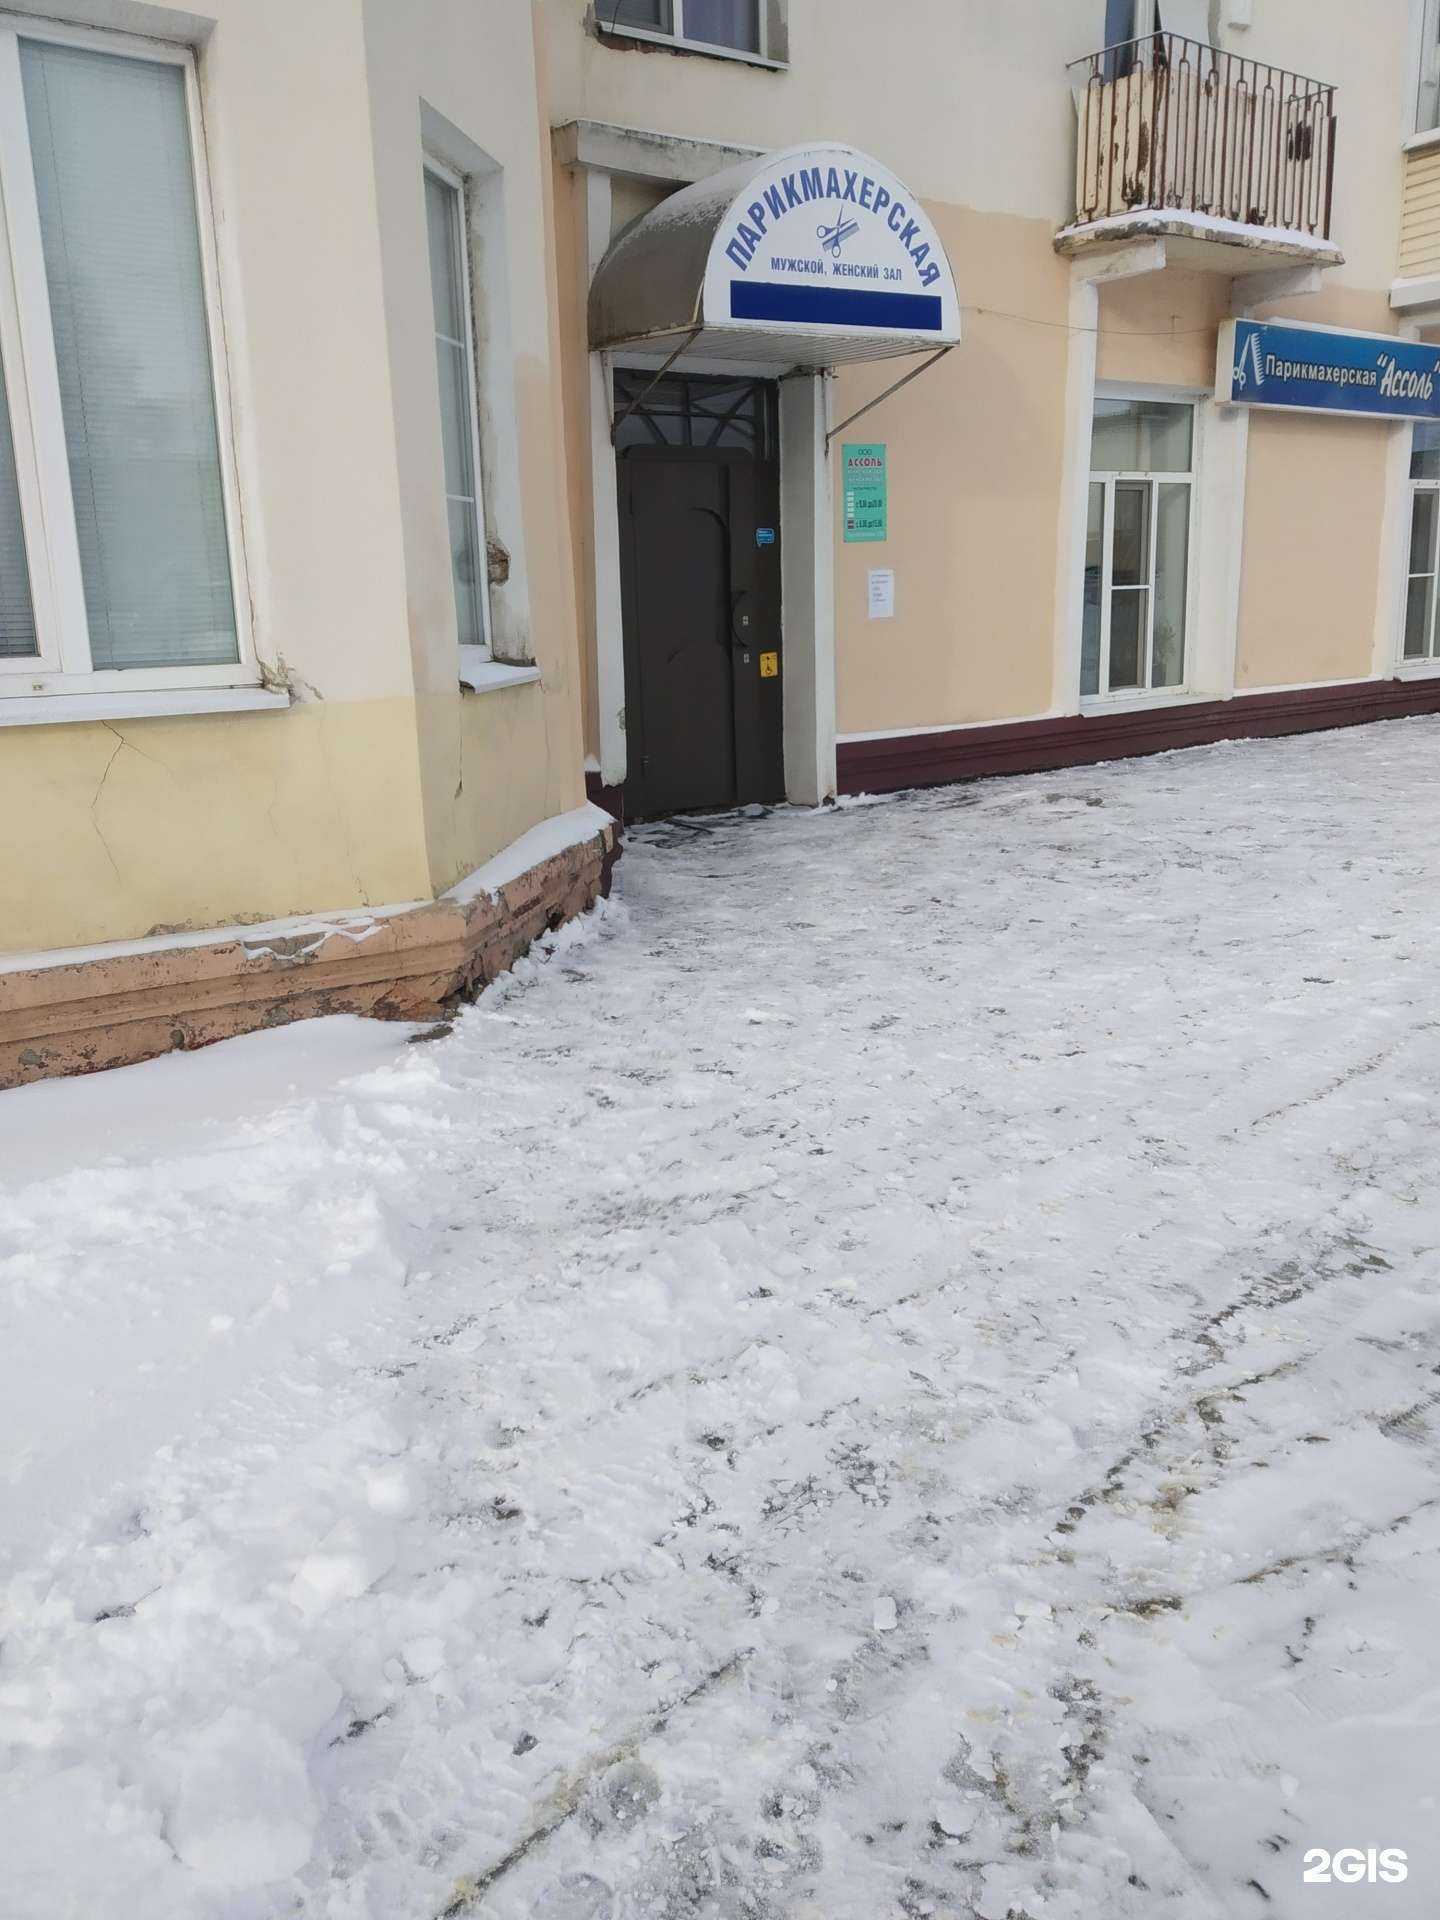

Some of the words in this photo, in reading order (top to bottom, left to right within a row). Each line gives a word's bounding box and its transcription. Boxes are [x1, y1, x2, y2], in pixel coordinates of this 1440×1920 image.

[725, 167, 941, 288] ПАРИКМАХЕРСКАЯ
[770, 257, 827, 276] МУЖСКОЙ,
[832, 262, 879, 279] ЖЕНСКИЙ
[883, 268, 902, 280] ЗАЛ
[1265, 354, 1377, 387] Парикмахерская
[848, 456, 882, 467] АССОЛЬ
